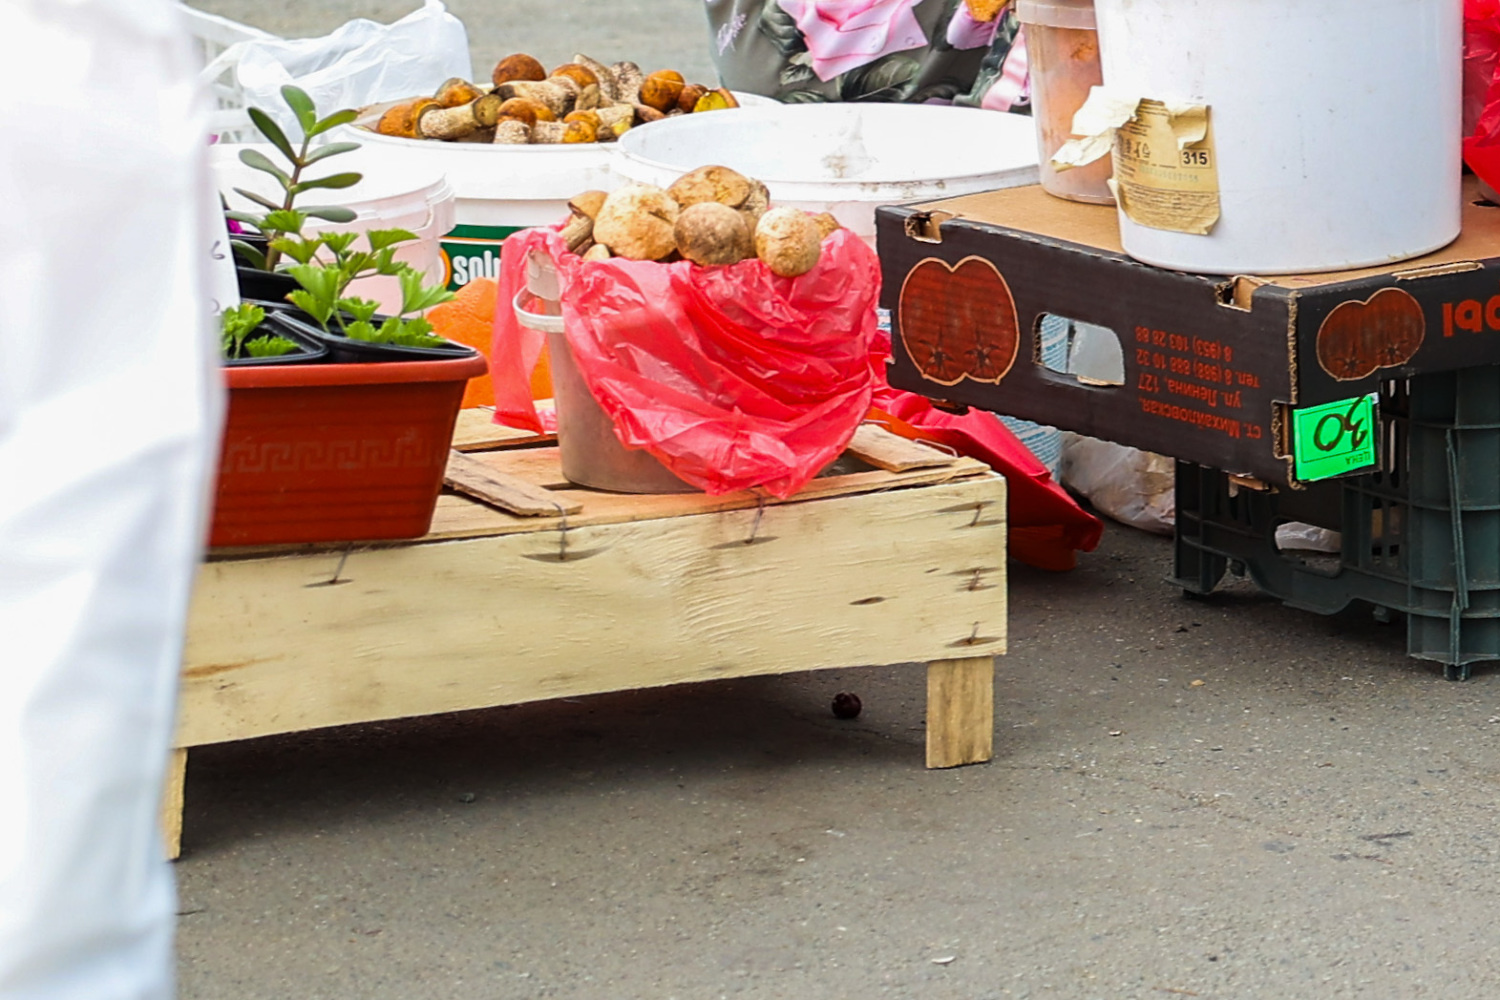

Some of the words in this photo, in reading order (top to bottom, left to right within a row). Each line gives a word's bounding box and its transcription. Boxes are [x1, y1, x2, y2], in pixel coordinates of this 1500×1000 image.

[1183, 151, 1208, 166] 315
[1136, 326, 1149, 342] 88
[1152, 331, 1166, 347] 28
[1169, 334, 1189, 352] 103
[1192, 335, 1222, 359] (953)
[1137, 348, 1150, 365] 32
[1224, 345, 1232, 361] 8
[1138, 374, 1159, 392] 127
[1224, 368, 1233, 385] 8
[1235, 371, 1260, 389] тел.
[1163, 376, 1218, 407] Ленина,
[1220, 390, 1242, 409] ул.
[1137, 397, 1241, 439] Михайловская,
[1313, 395, 1368, 453] 30
[1243, 423, 1262, 440] ст.
[1345, 451, 1371, 465] ЦЕНА
